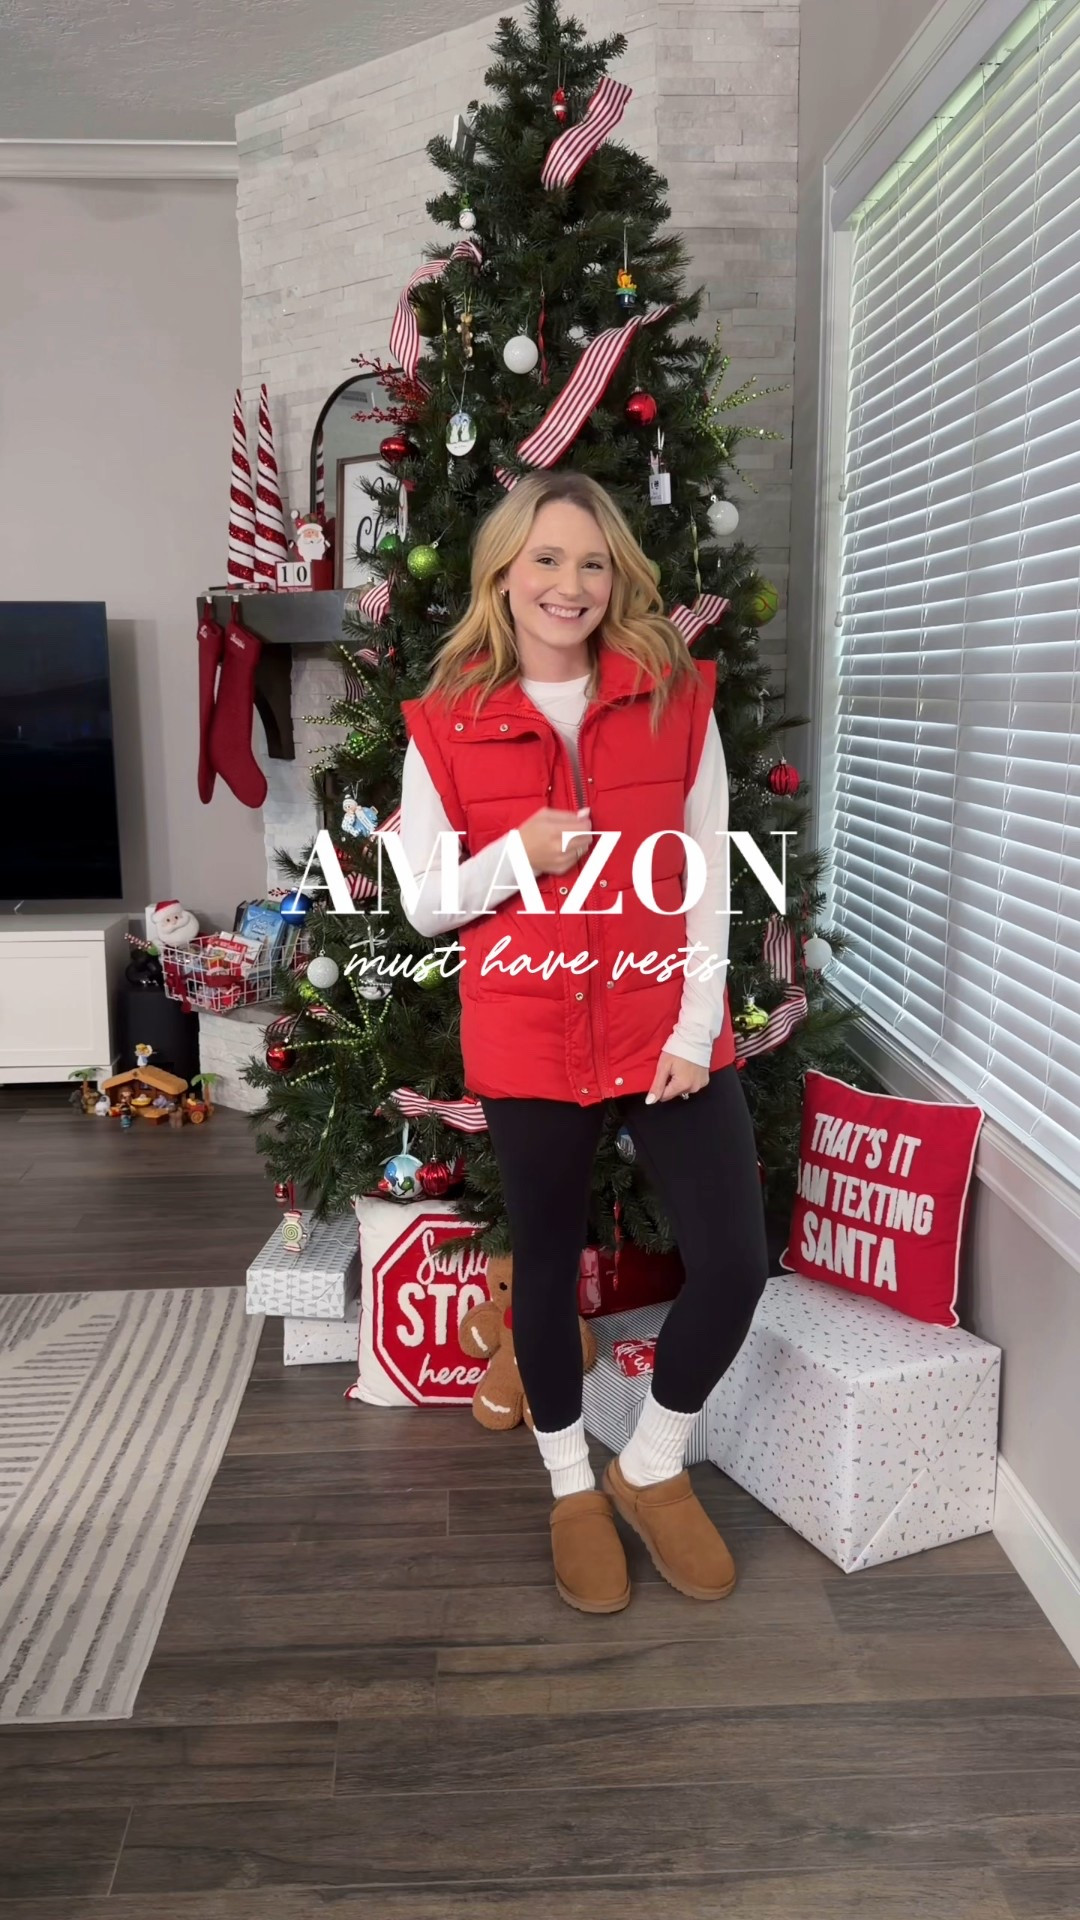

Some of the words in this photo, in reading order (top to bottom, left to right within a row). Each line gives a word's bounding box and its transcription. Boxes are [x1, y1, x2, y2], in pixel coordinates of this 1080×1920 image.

[810, 1112, 888, 1170] THAT'S
[888, 1133, 922, 1178] IT
[801, 1162, 830, 1208] AM
[831, 1171, 935, 1236] TEXTING
[801, 1210, 898, 1292] SANTA
[396, 1282, 486, 1347] STO
